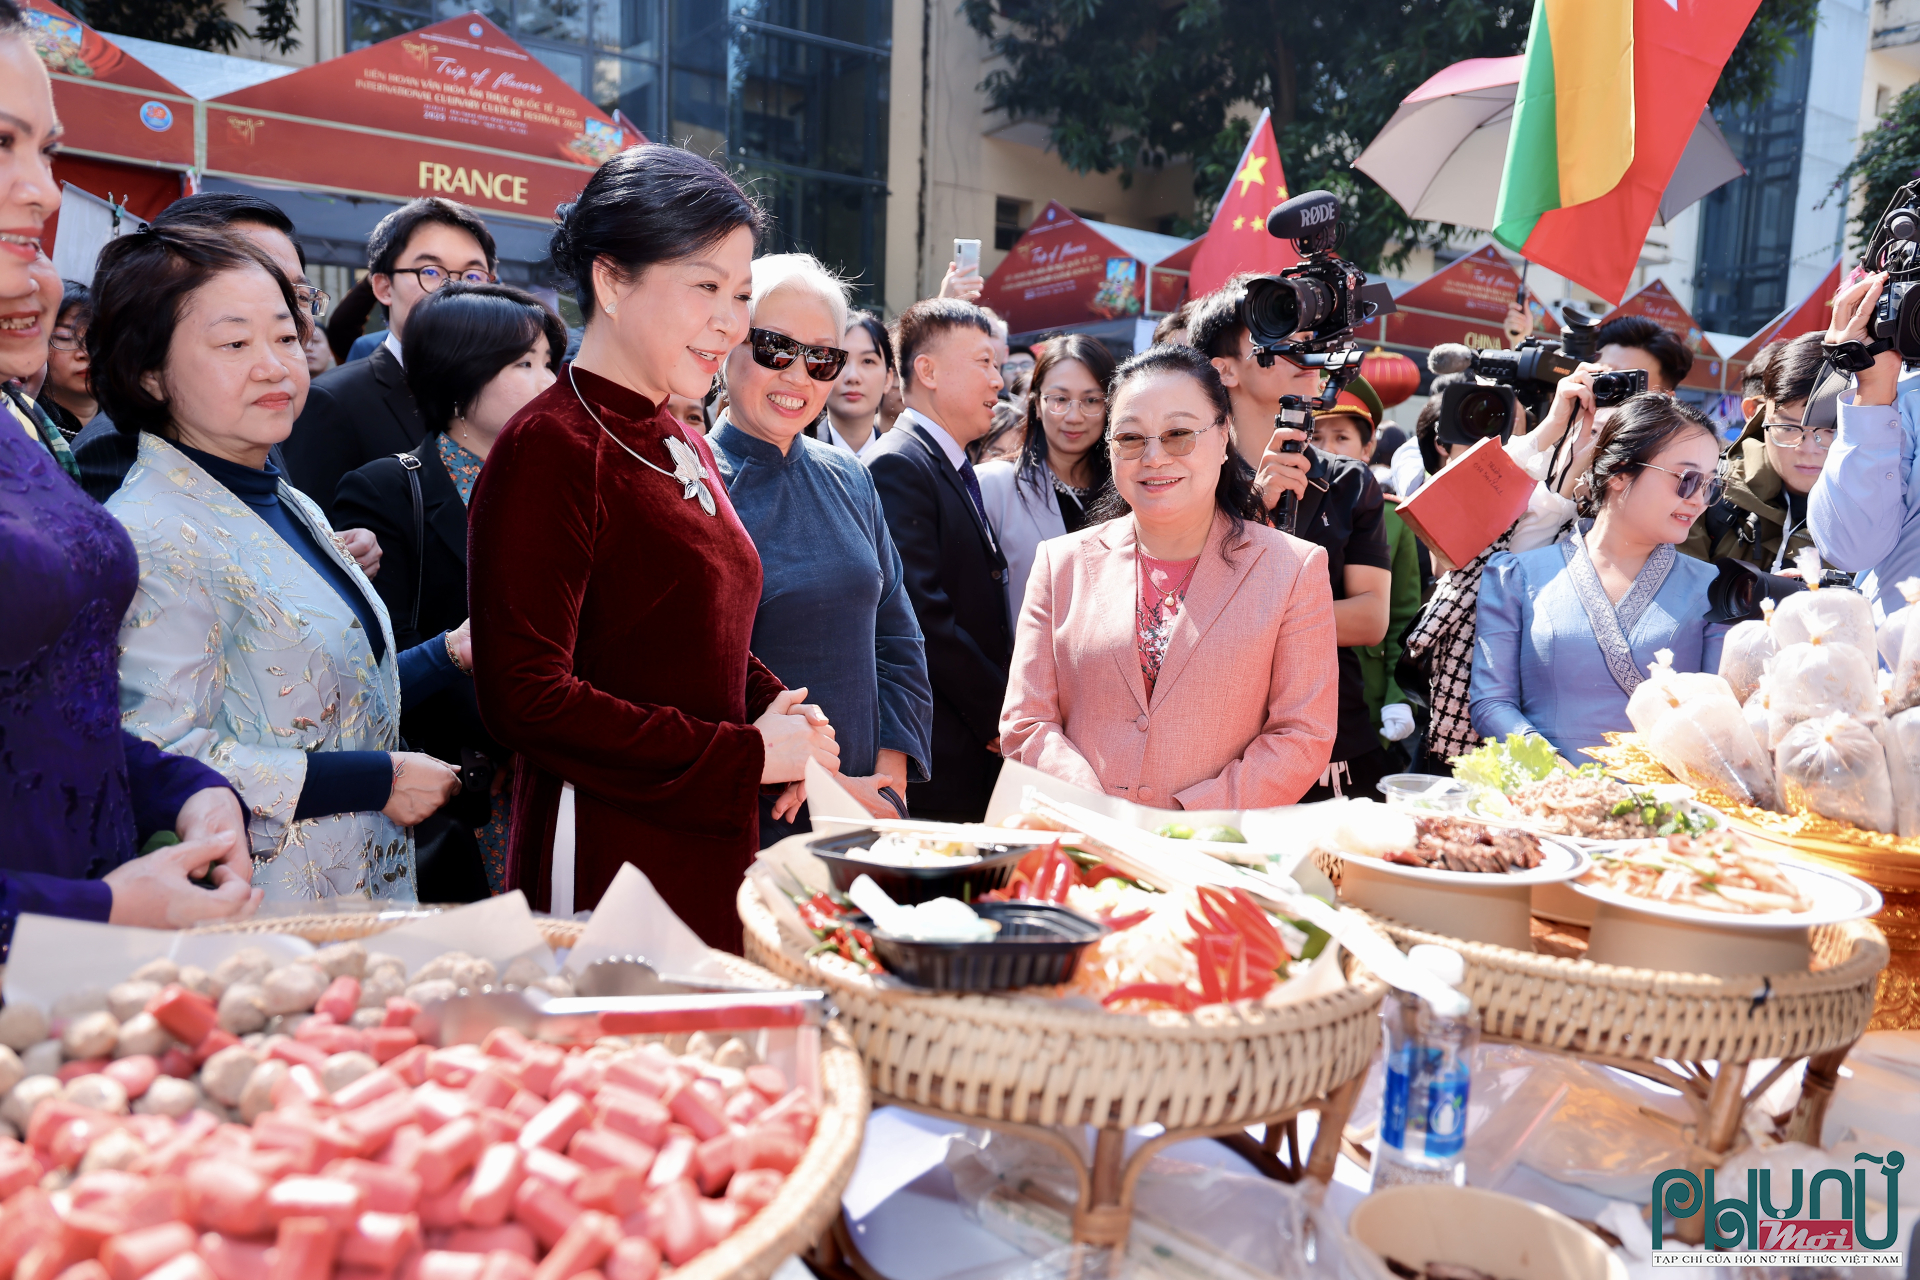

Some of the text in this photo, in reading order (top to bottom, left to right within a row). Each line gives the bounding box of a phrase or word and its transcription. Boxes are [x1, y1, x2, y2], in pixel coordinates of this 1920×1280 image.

[388, 73, 420, 87] HOAN
[555, 105, 577, 118] 2025
[432, 56, 543, 94] Trip of flavors
[355, 78, 433, 102] INTERNATIONAL
[434, 93, 480, 111] CULINARY
[481, 101, 521, 118] CULTURE
[523, 110, 560, 126] FESTIVAL
[562, 117, 584, 129] 2025
[419, 161, 528, 205] FRANCE
[1300, 202, 1335, 227] RØDE
[1464, 331, 1502, 350] CHINA
